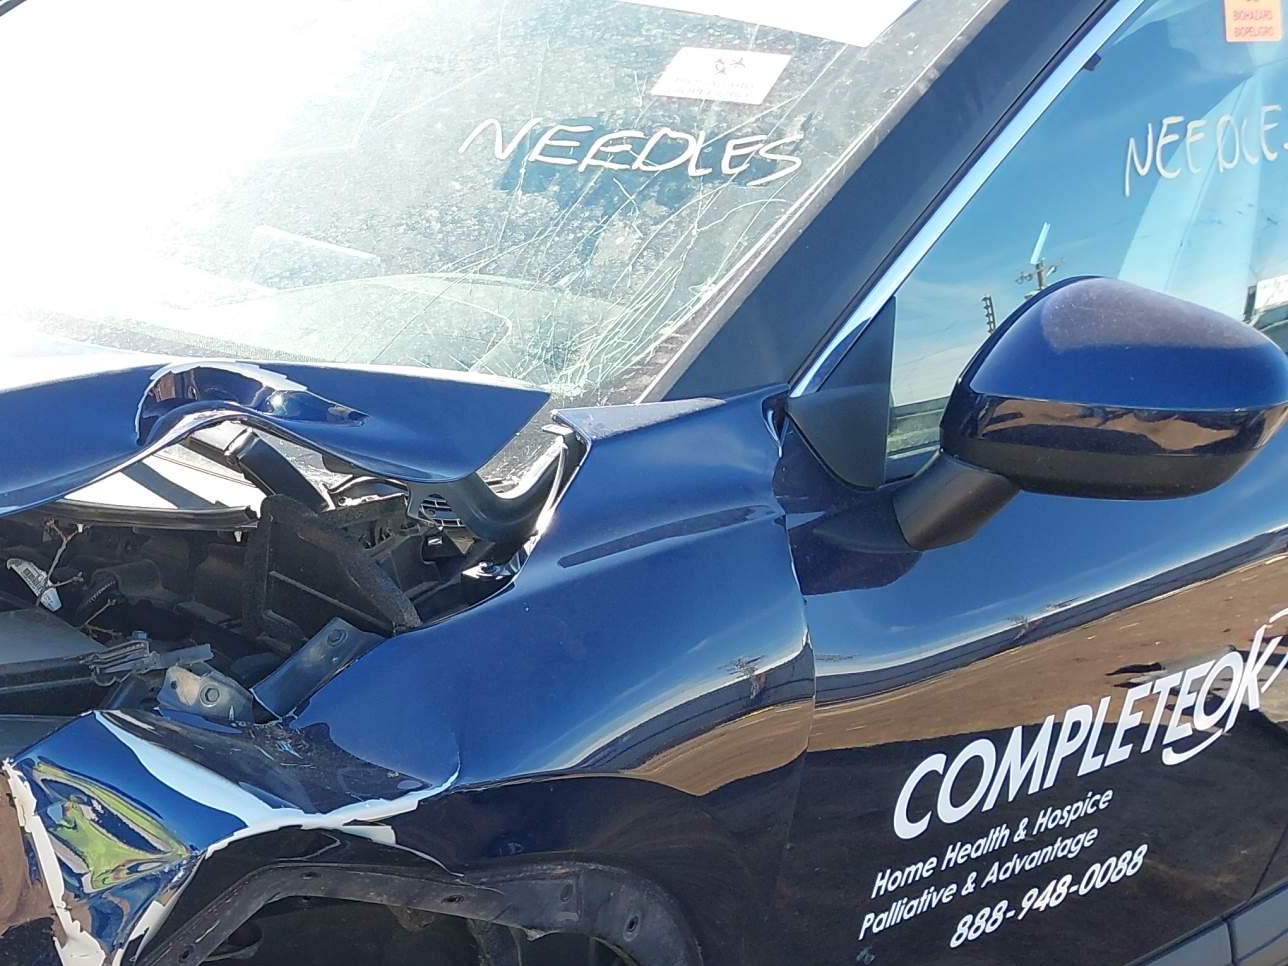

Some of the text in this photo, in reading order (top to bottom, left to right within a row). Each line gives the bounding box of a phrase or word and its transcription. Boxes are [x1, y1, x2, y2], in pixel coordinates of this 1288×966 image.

[459, 118, 804, 187] NEEDLES
[1124, 104, 1288, 197] NEEDLE
[859, 828, 1098, 940] Palliative & Advantage
[871, 789, 1113, 898] Home Health & Hospice
[949, 844, 1147, 948] 888-948-0088
